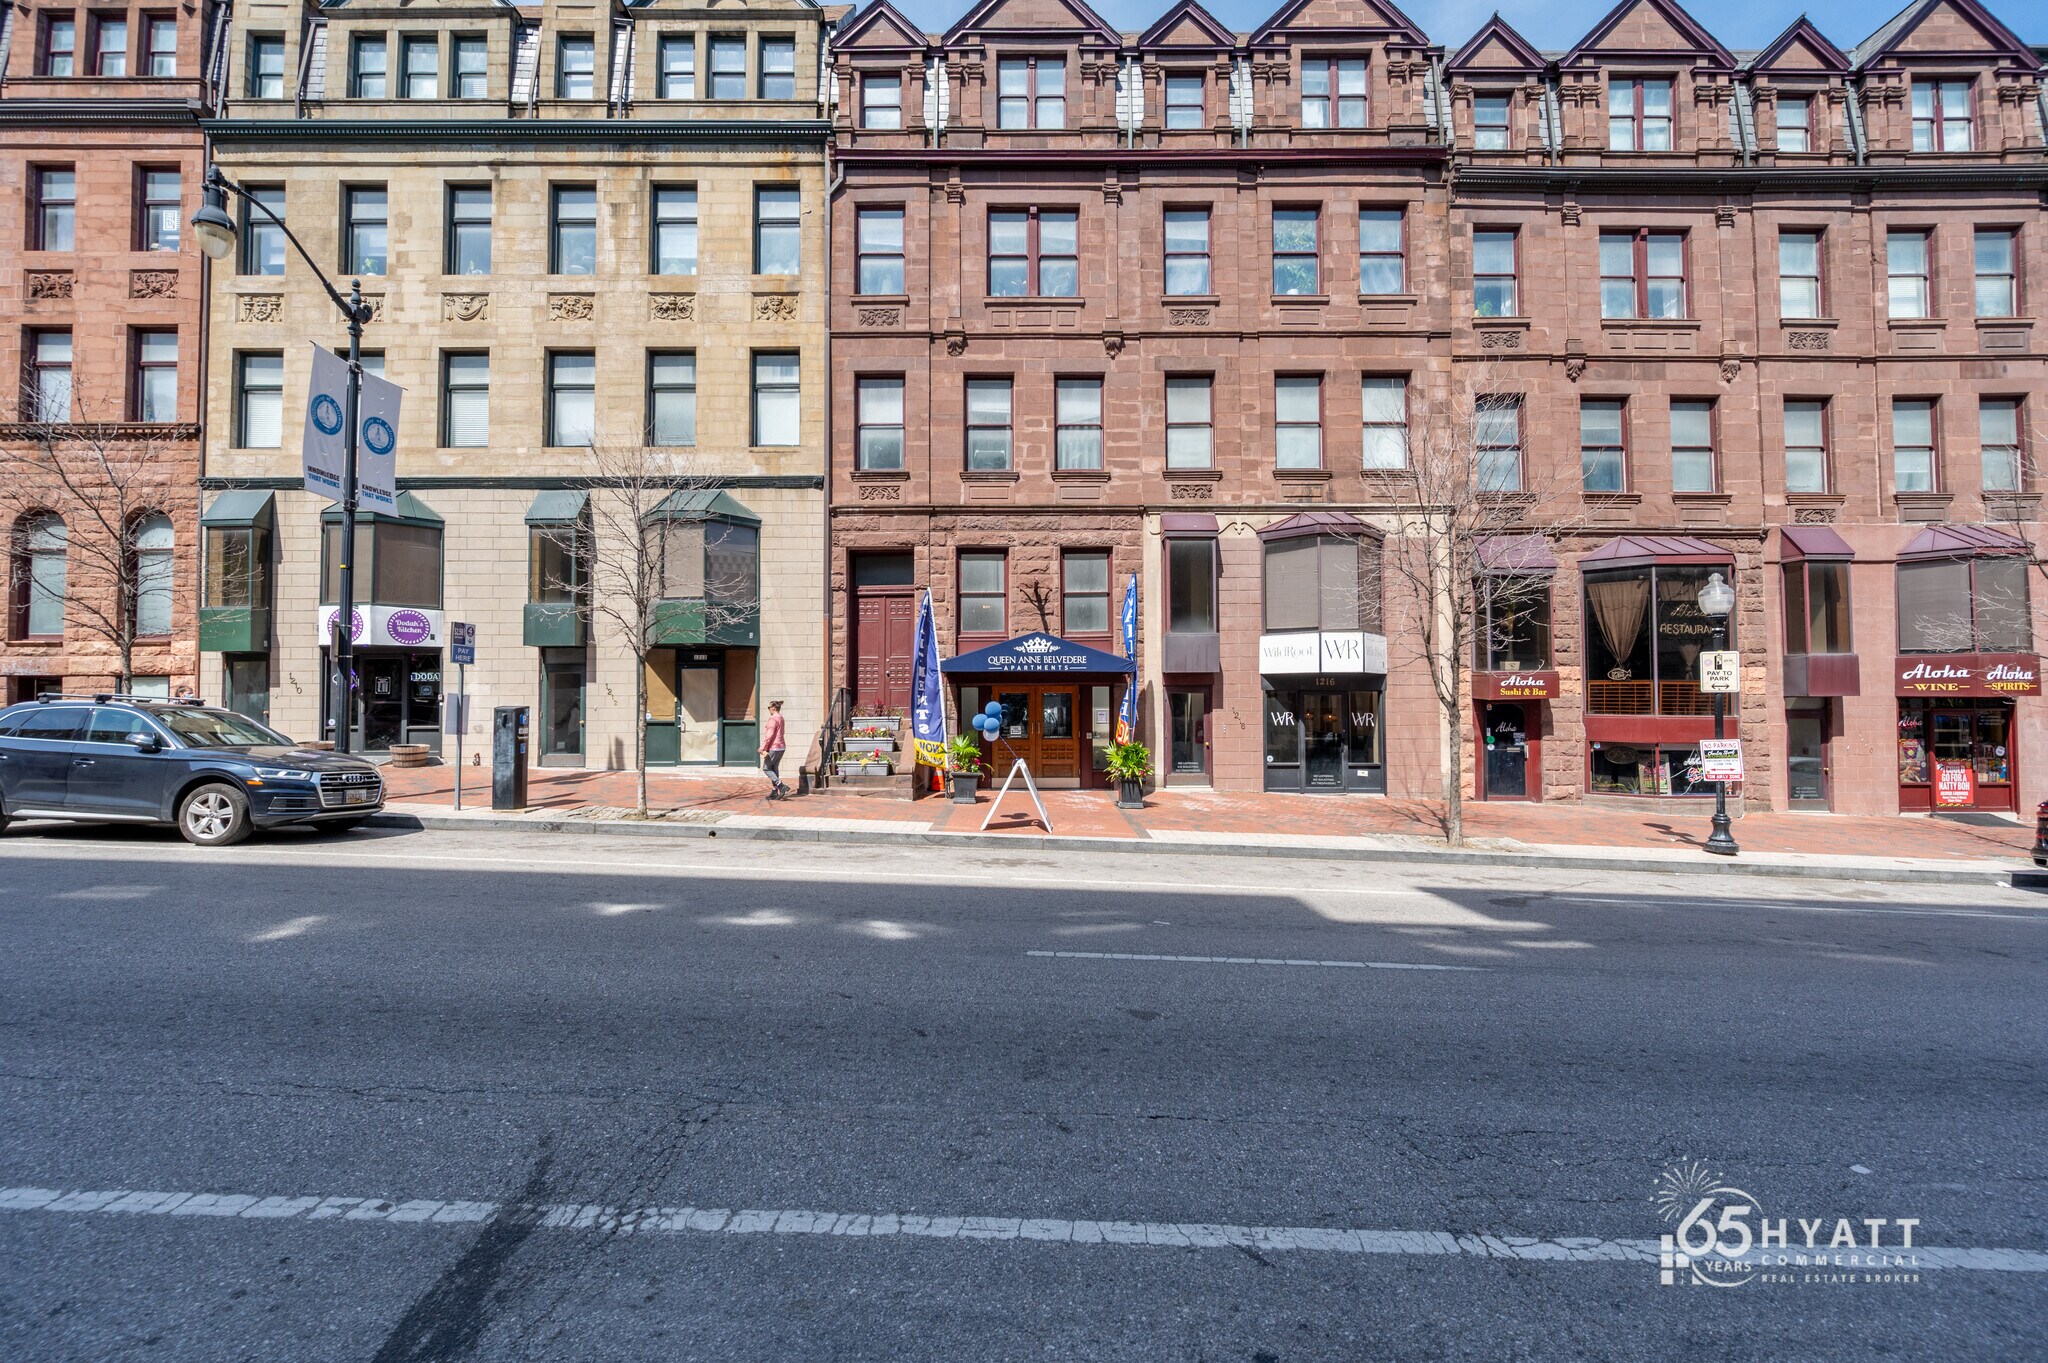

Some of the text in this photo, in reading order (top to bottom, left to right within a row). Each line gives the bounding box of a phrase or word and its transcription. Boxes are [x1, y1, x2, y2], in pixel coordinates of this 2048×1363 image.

[308, 473, 340, 488] THAT WORKS
[362, 484, 391, 497] KNOWLEDGE
[362, 490, 392, 504] THAT WORKS
[1660, 623, 1712, 634] RESTAURA
[1264, 646, 1314, 658] WildRoot
[1325, 640, 1359, 659] WR
[988, 656, 1016, 665] QUEEN
[1902, 664, 2034, 680] Aloha Aloha
[1501, 675, 1545, 686] Aloha
[1271, 712, 1374, 726] WR WR
[1898, 716, 1923, 727] Aloha
[1496, 722, 1517, 732] Aloha
[1942, 774, 1967, 782] GO FOR A
[1939, 782, 1970, 790] NATTY BOH
